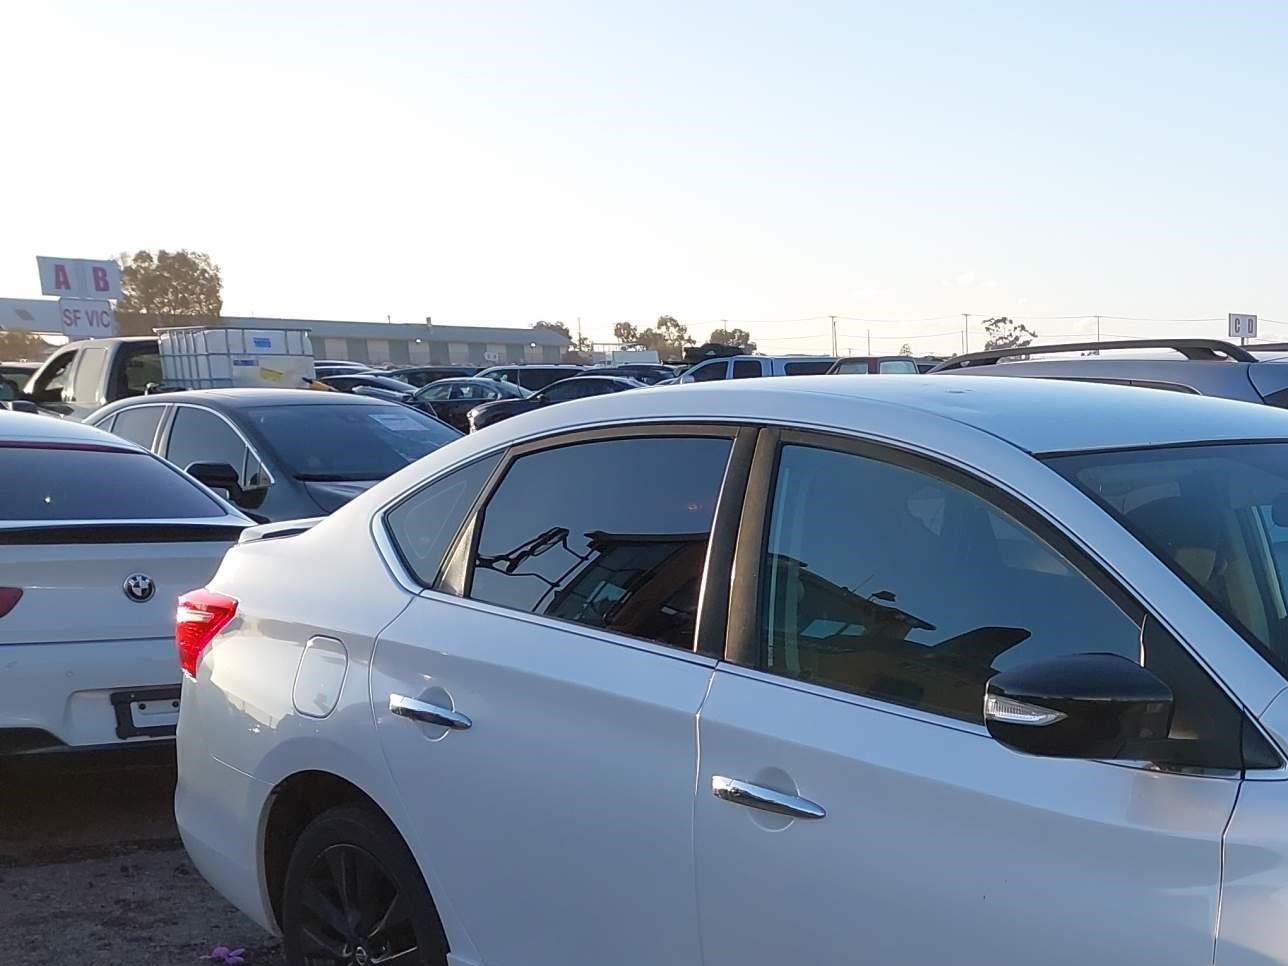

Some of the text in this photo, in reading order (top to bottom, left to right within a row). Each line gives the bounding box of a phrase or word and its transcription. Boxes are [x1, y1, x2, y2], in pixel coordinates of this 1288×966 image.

[54, 264, 109, 292] A B
[63, 308, 111, 328] SF VIC
[1235, 318, 1254, 334] C D
